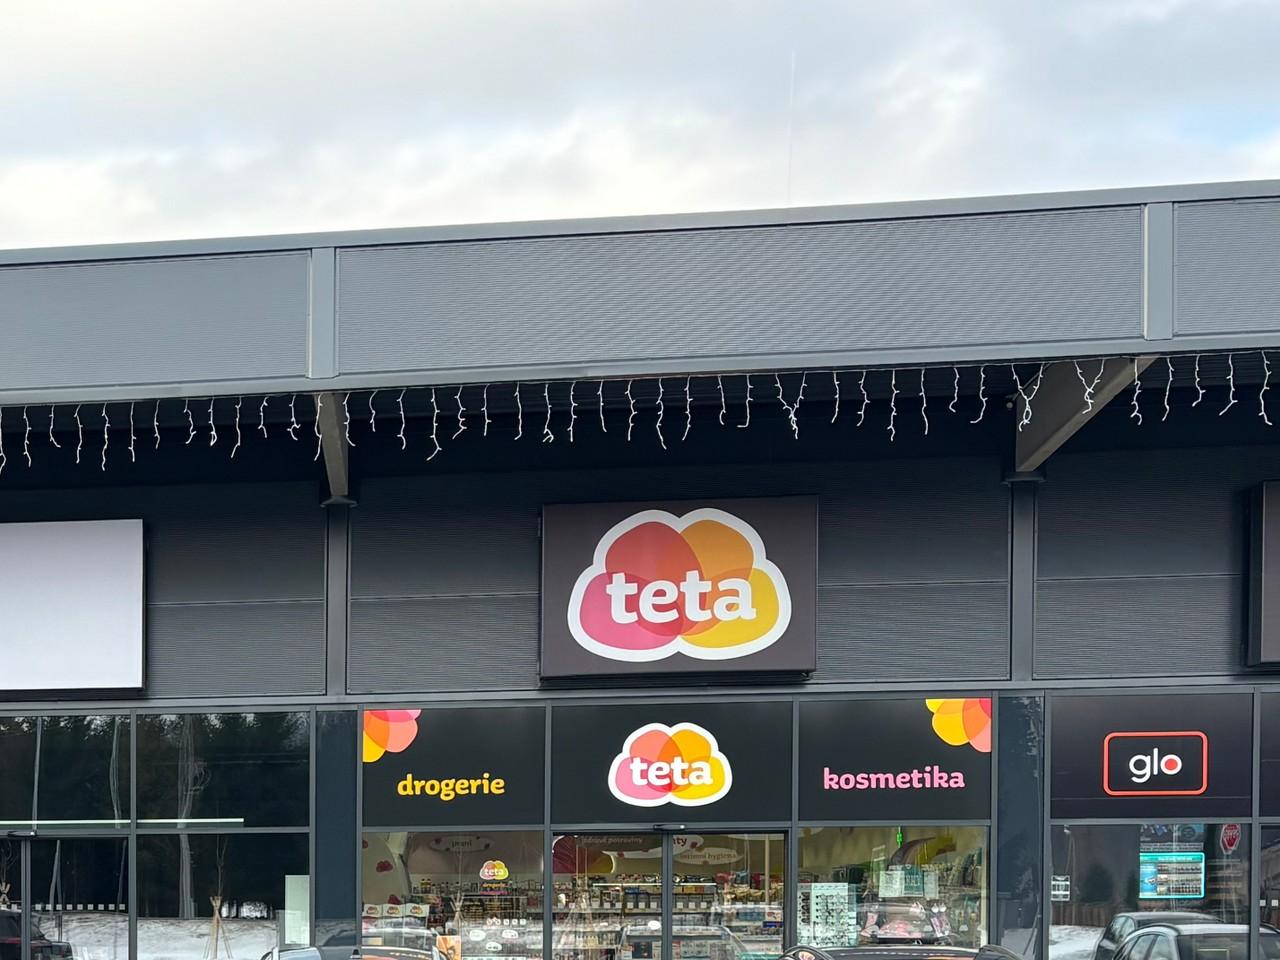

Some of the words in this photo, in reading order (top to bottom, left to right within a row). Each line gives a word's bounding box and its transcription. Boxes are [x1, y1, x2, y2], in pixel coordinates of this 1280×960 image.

[606, 570, 756, 623] teta
[629, 755, 713, 787] teta
[823, 765, 965, 790] kosmetika
[1128, 748, 1182, 783] glo
[397, 772, 505, 800] drogerie
